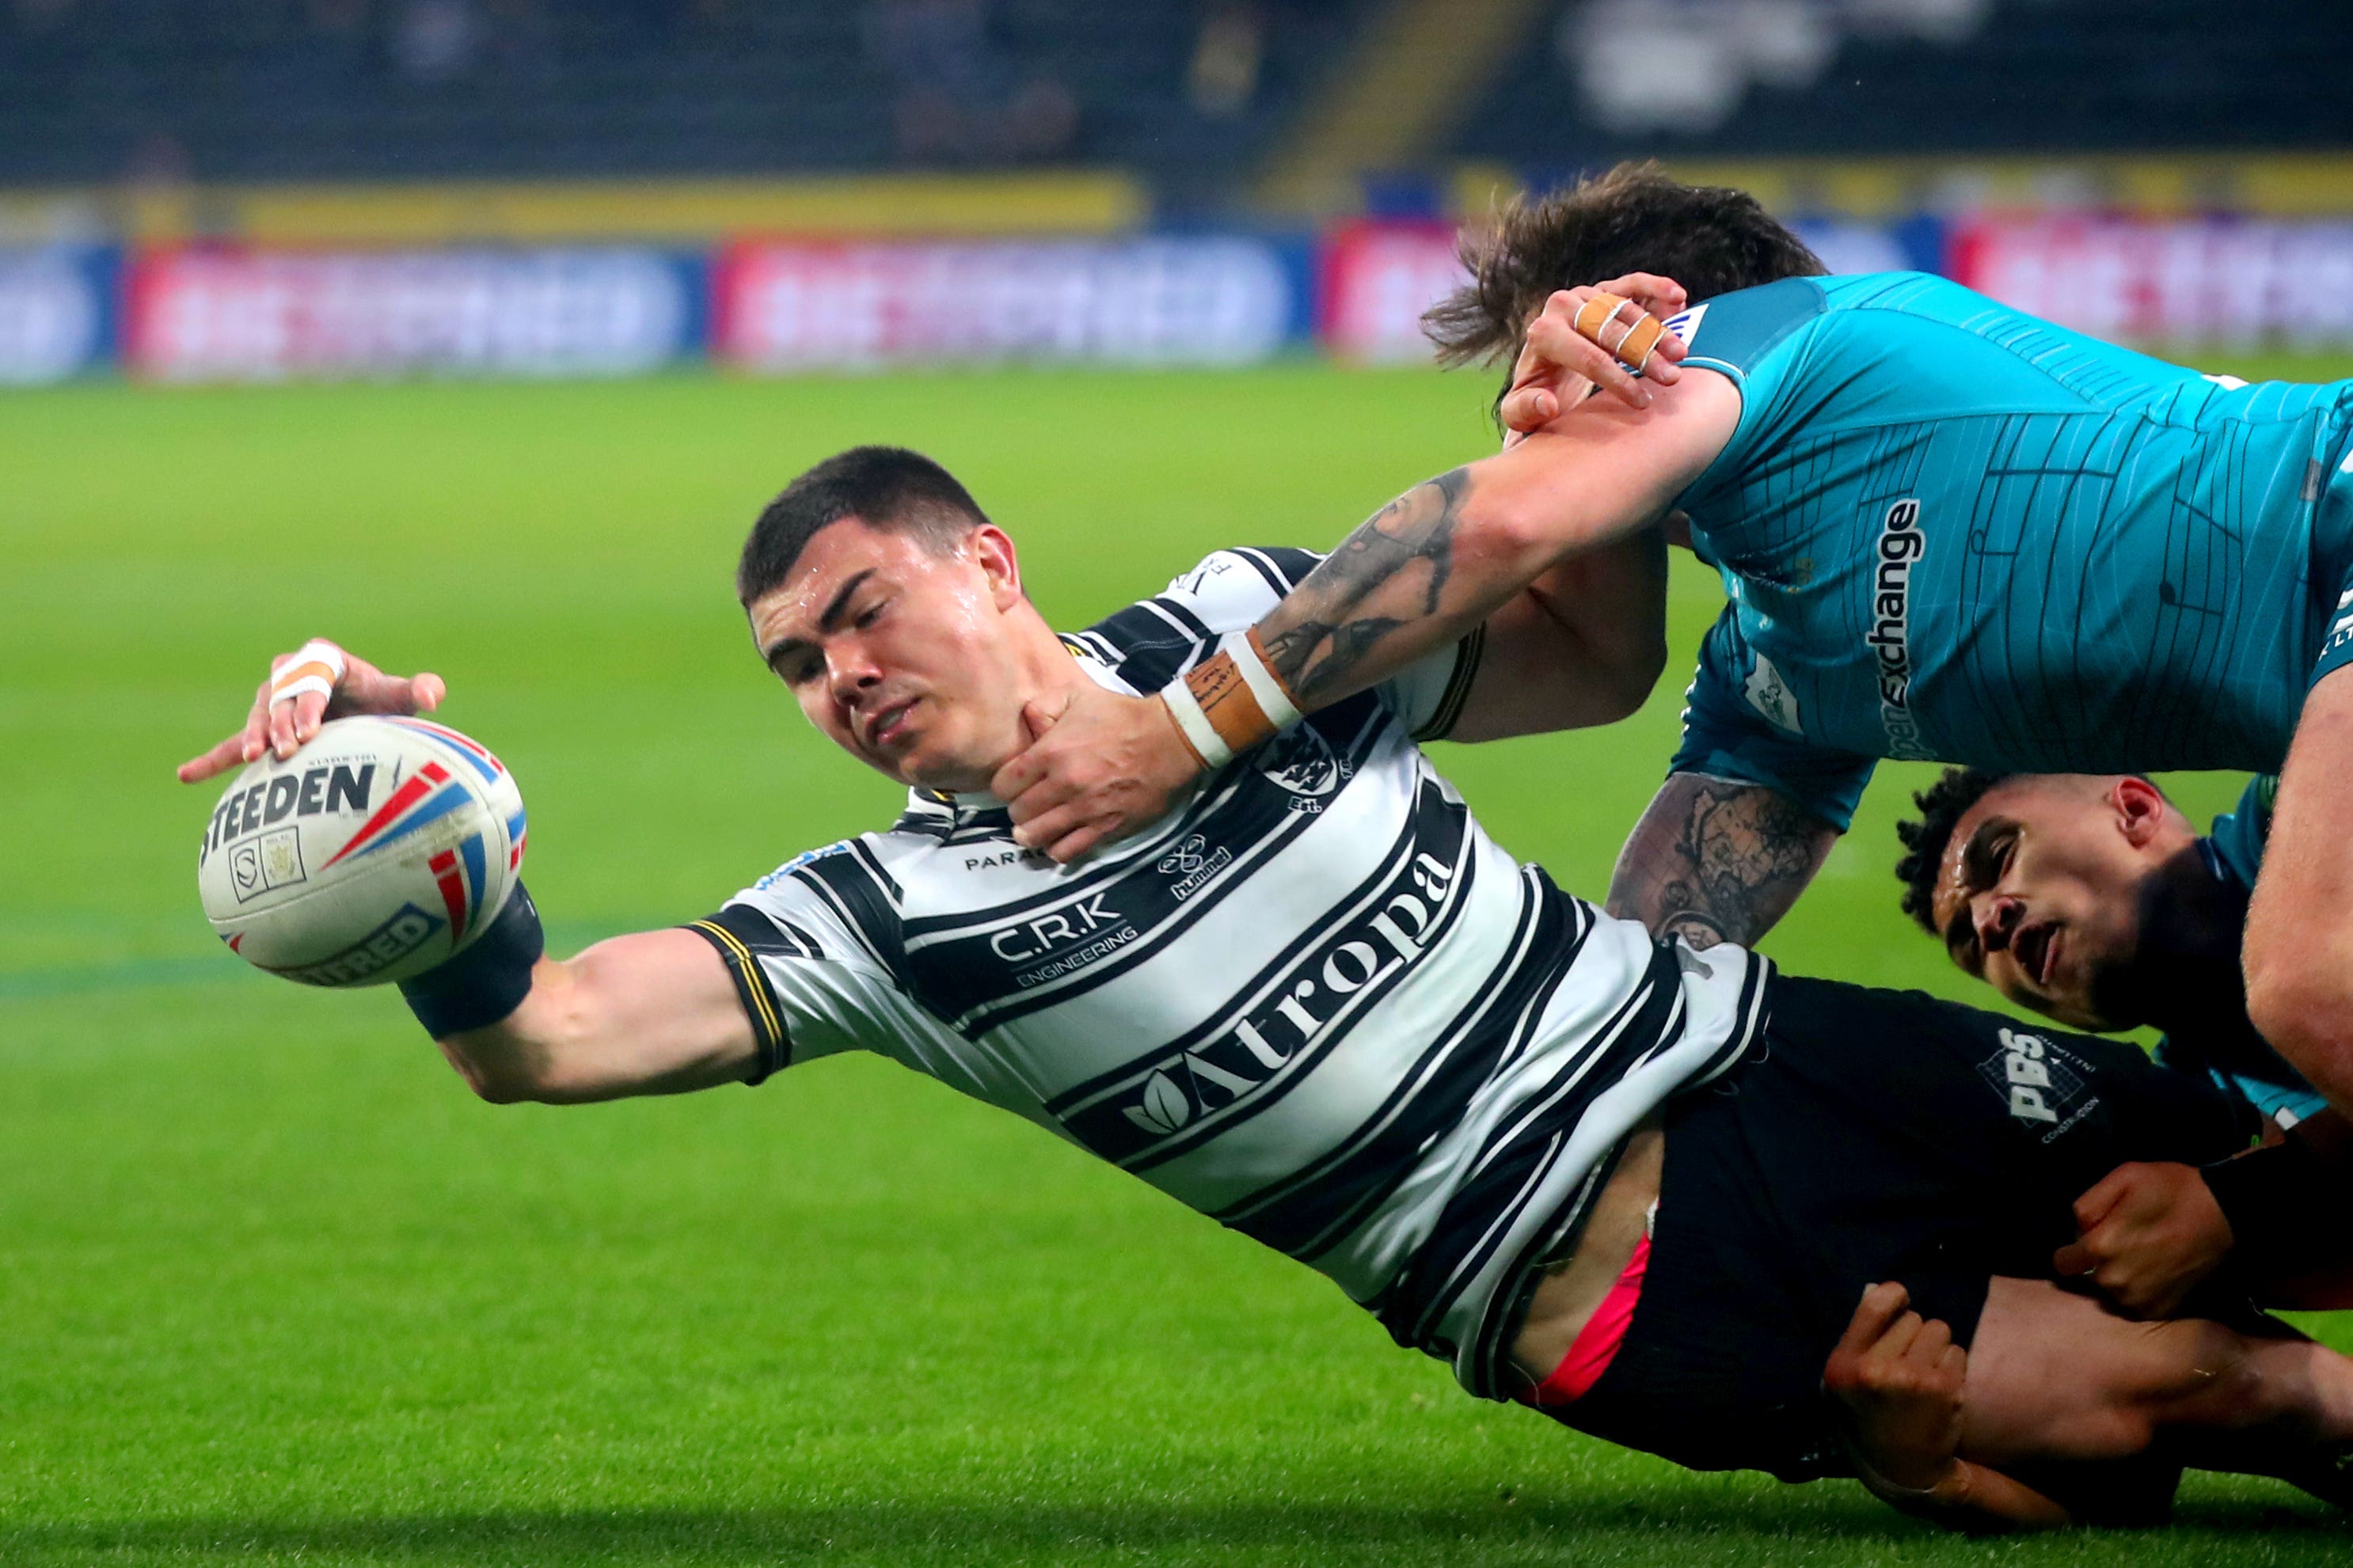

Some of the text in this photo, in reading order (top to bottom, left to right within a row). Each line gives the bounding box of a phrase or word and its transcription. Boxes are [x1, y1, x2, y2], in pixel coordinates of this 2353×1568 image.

[1867, 500, 1933, 757] penExchange
[965, 847, 1045, 871] PARA
[1170, 845, 1233, 901] hummel
[990, 892, 1121, 962] C.R.K
[1016, 925, 1138, 988] ENGINEERING
[1182, 852, 1454, 1117] Atropa
